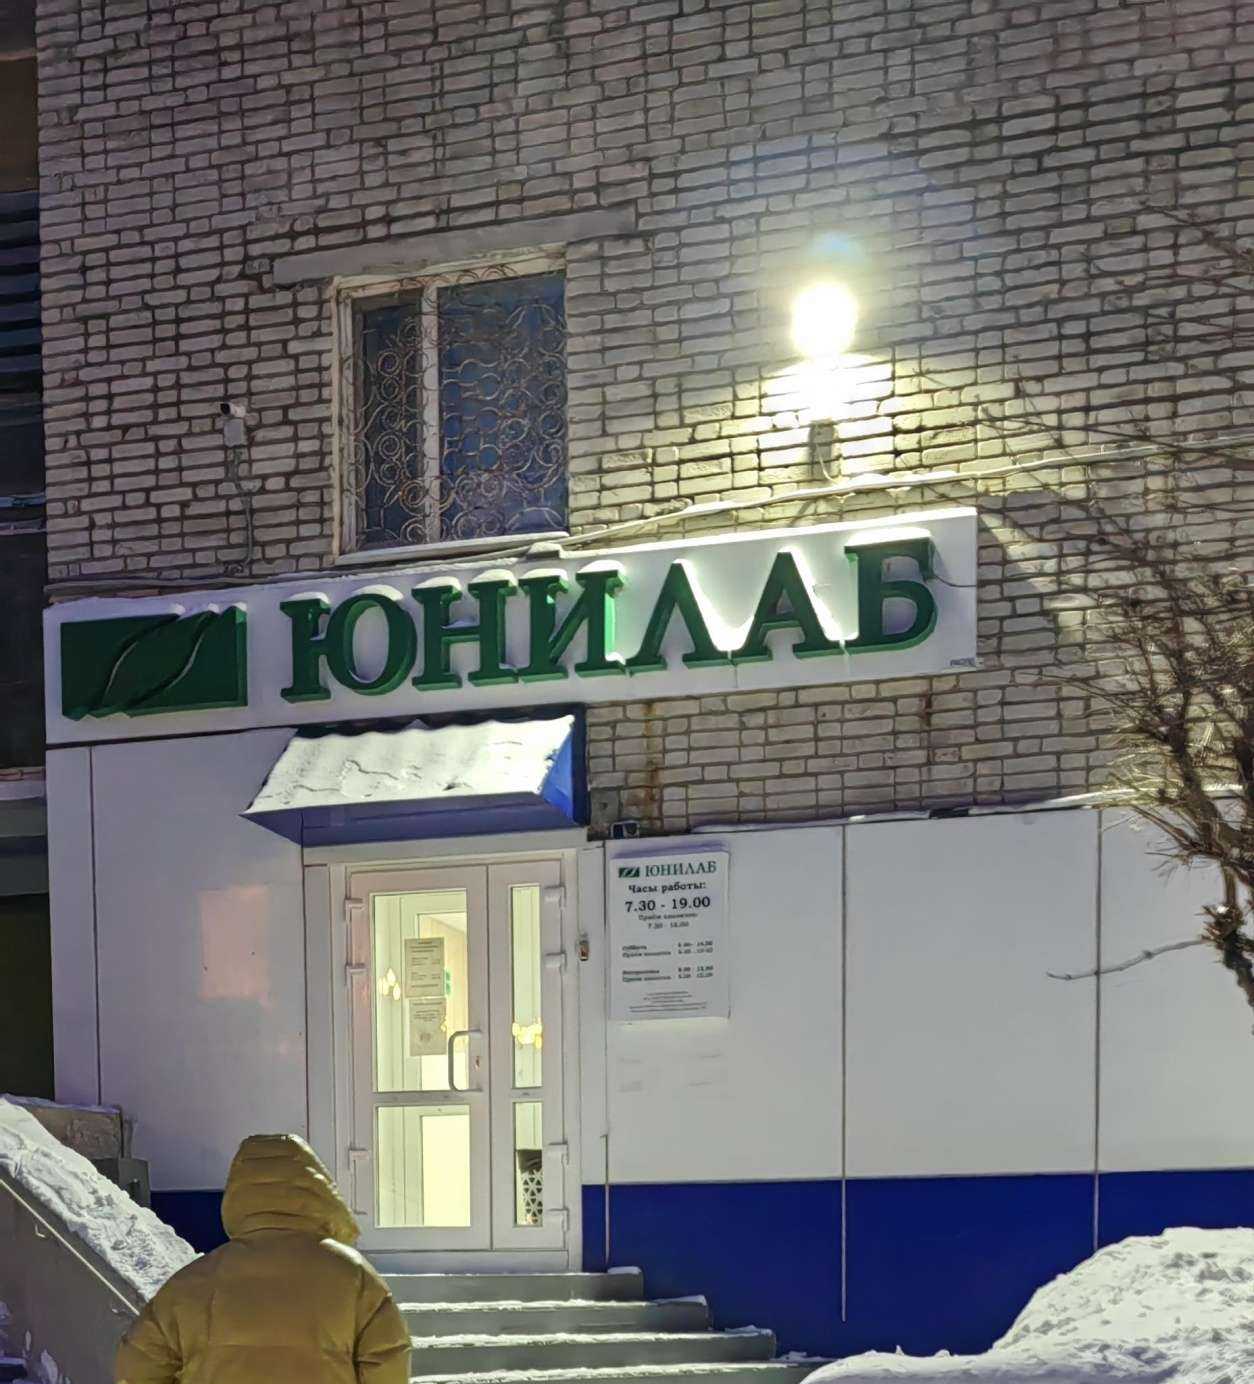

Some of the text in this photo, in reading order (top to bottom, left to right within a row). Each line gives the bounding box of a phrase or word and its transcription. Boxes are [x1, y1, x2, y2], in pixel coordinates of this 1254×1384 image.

[280, 536, 938, 700] ЮНИЛАБ
[645, 861, 717, 877] ЮНИЛАБ
[628, 881, 706, 894] Часы работы:
[625, 900, 656, 912] 7.30
[672, 896, 711, 910] 19.00
